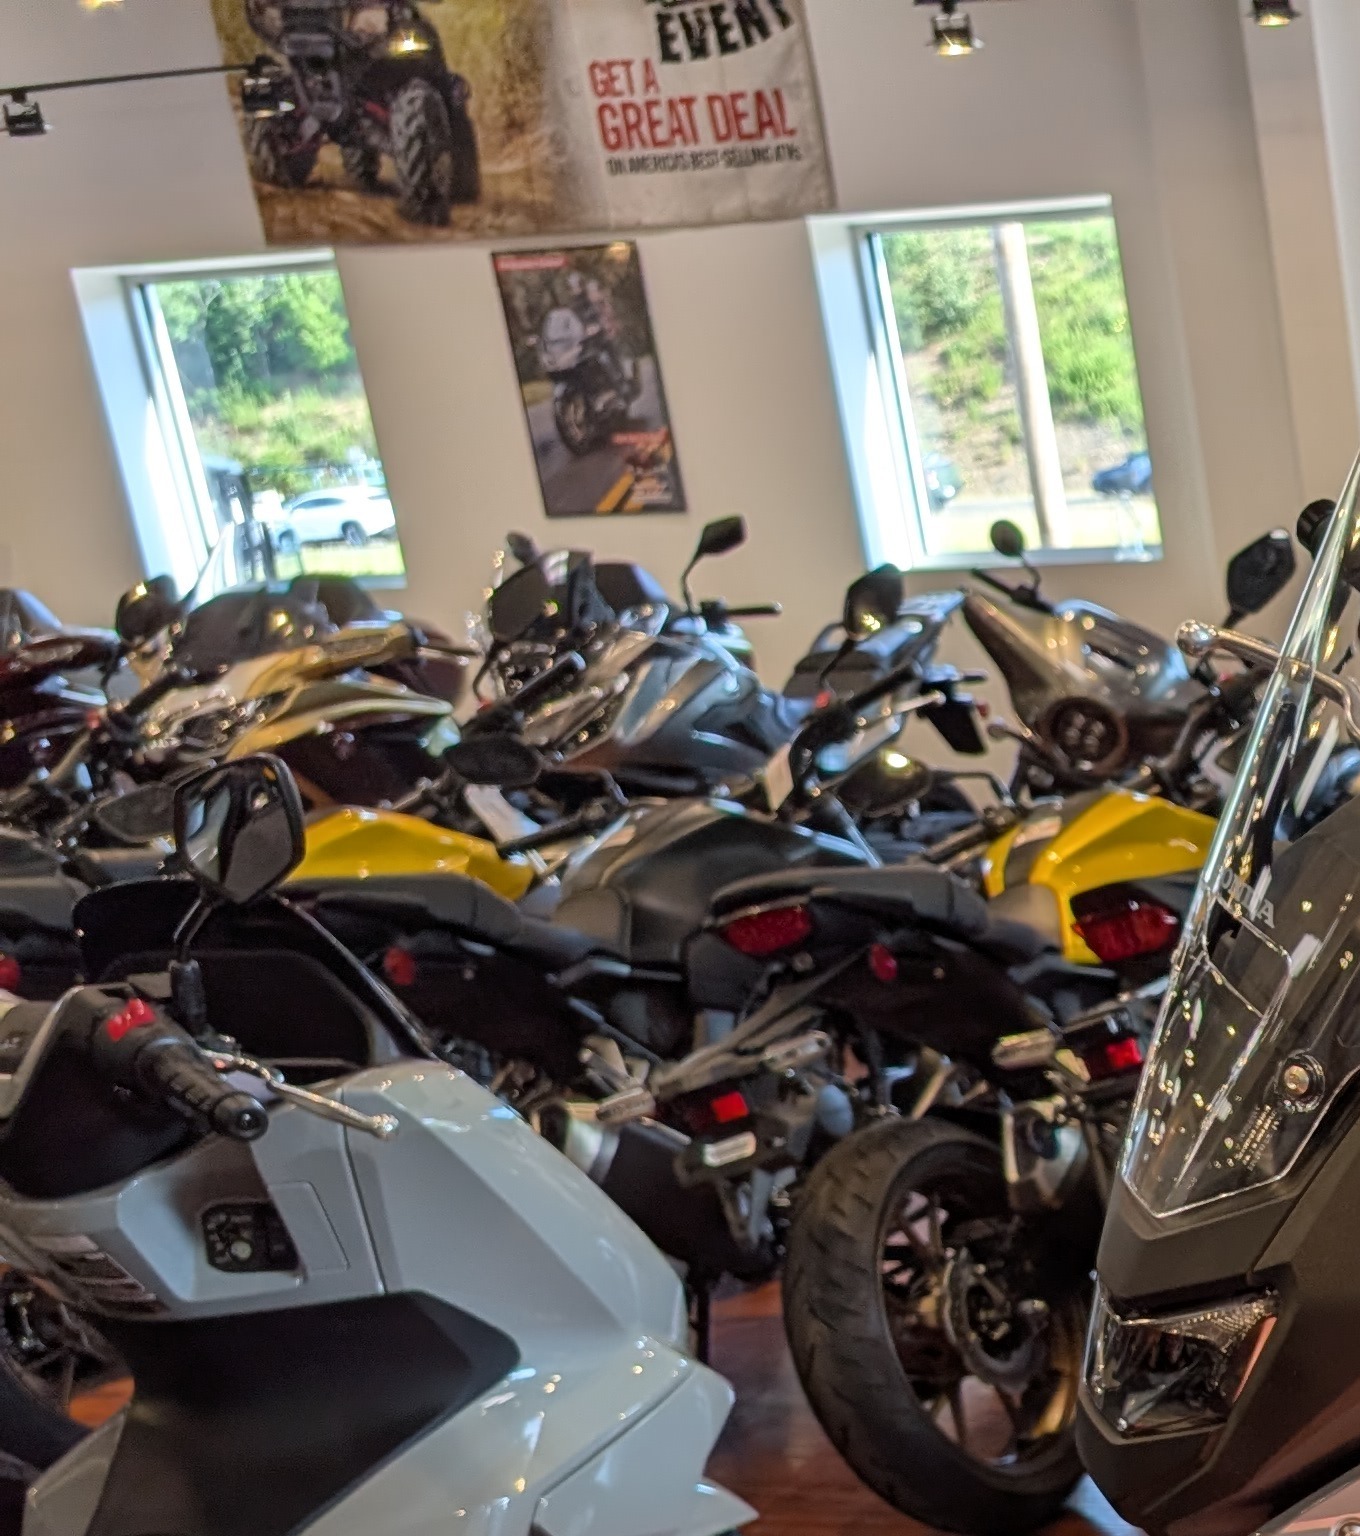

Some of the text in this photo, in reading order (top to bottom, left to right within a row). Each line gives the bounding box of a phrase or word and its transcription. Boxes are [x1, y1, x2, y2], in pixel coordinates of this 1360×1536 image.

[588, 58, 660, 98] GET A
[597, 87, 797, 152] GREAT DEAL
